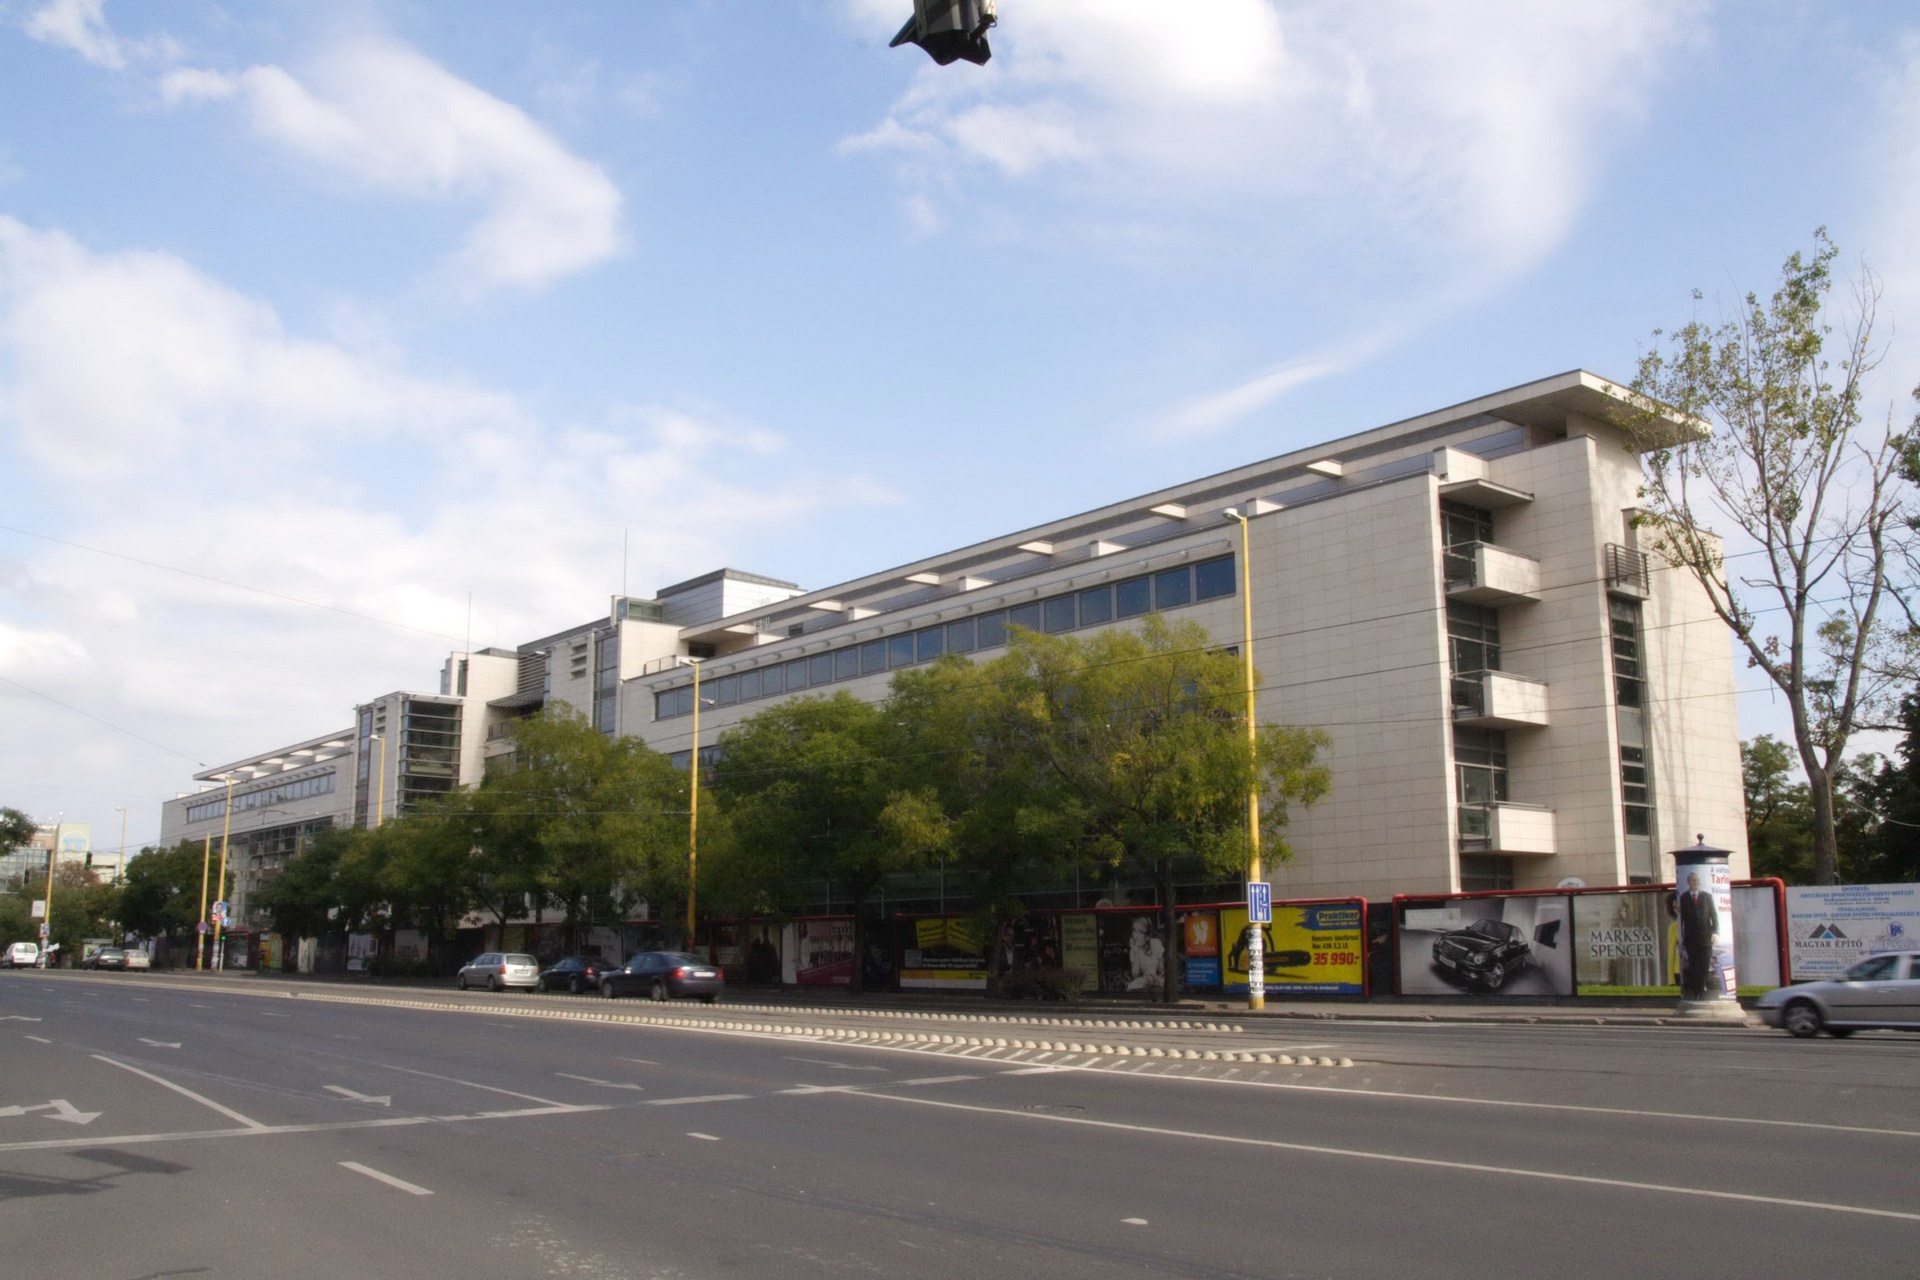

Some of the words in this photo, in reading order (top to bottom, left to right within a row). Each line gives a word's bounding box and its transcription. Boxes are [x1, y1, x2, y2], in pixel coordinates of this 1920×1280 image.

[1794, 940, 1831, 948] MAGYAR
[1835, 938, 1863, 948] ÉPÍTŐ
[1590, 943, 1654, 957] SPENCER
[1313, 952, 1329, 965] 35
